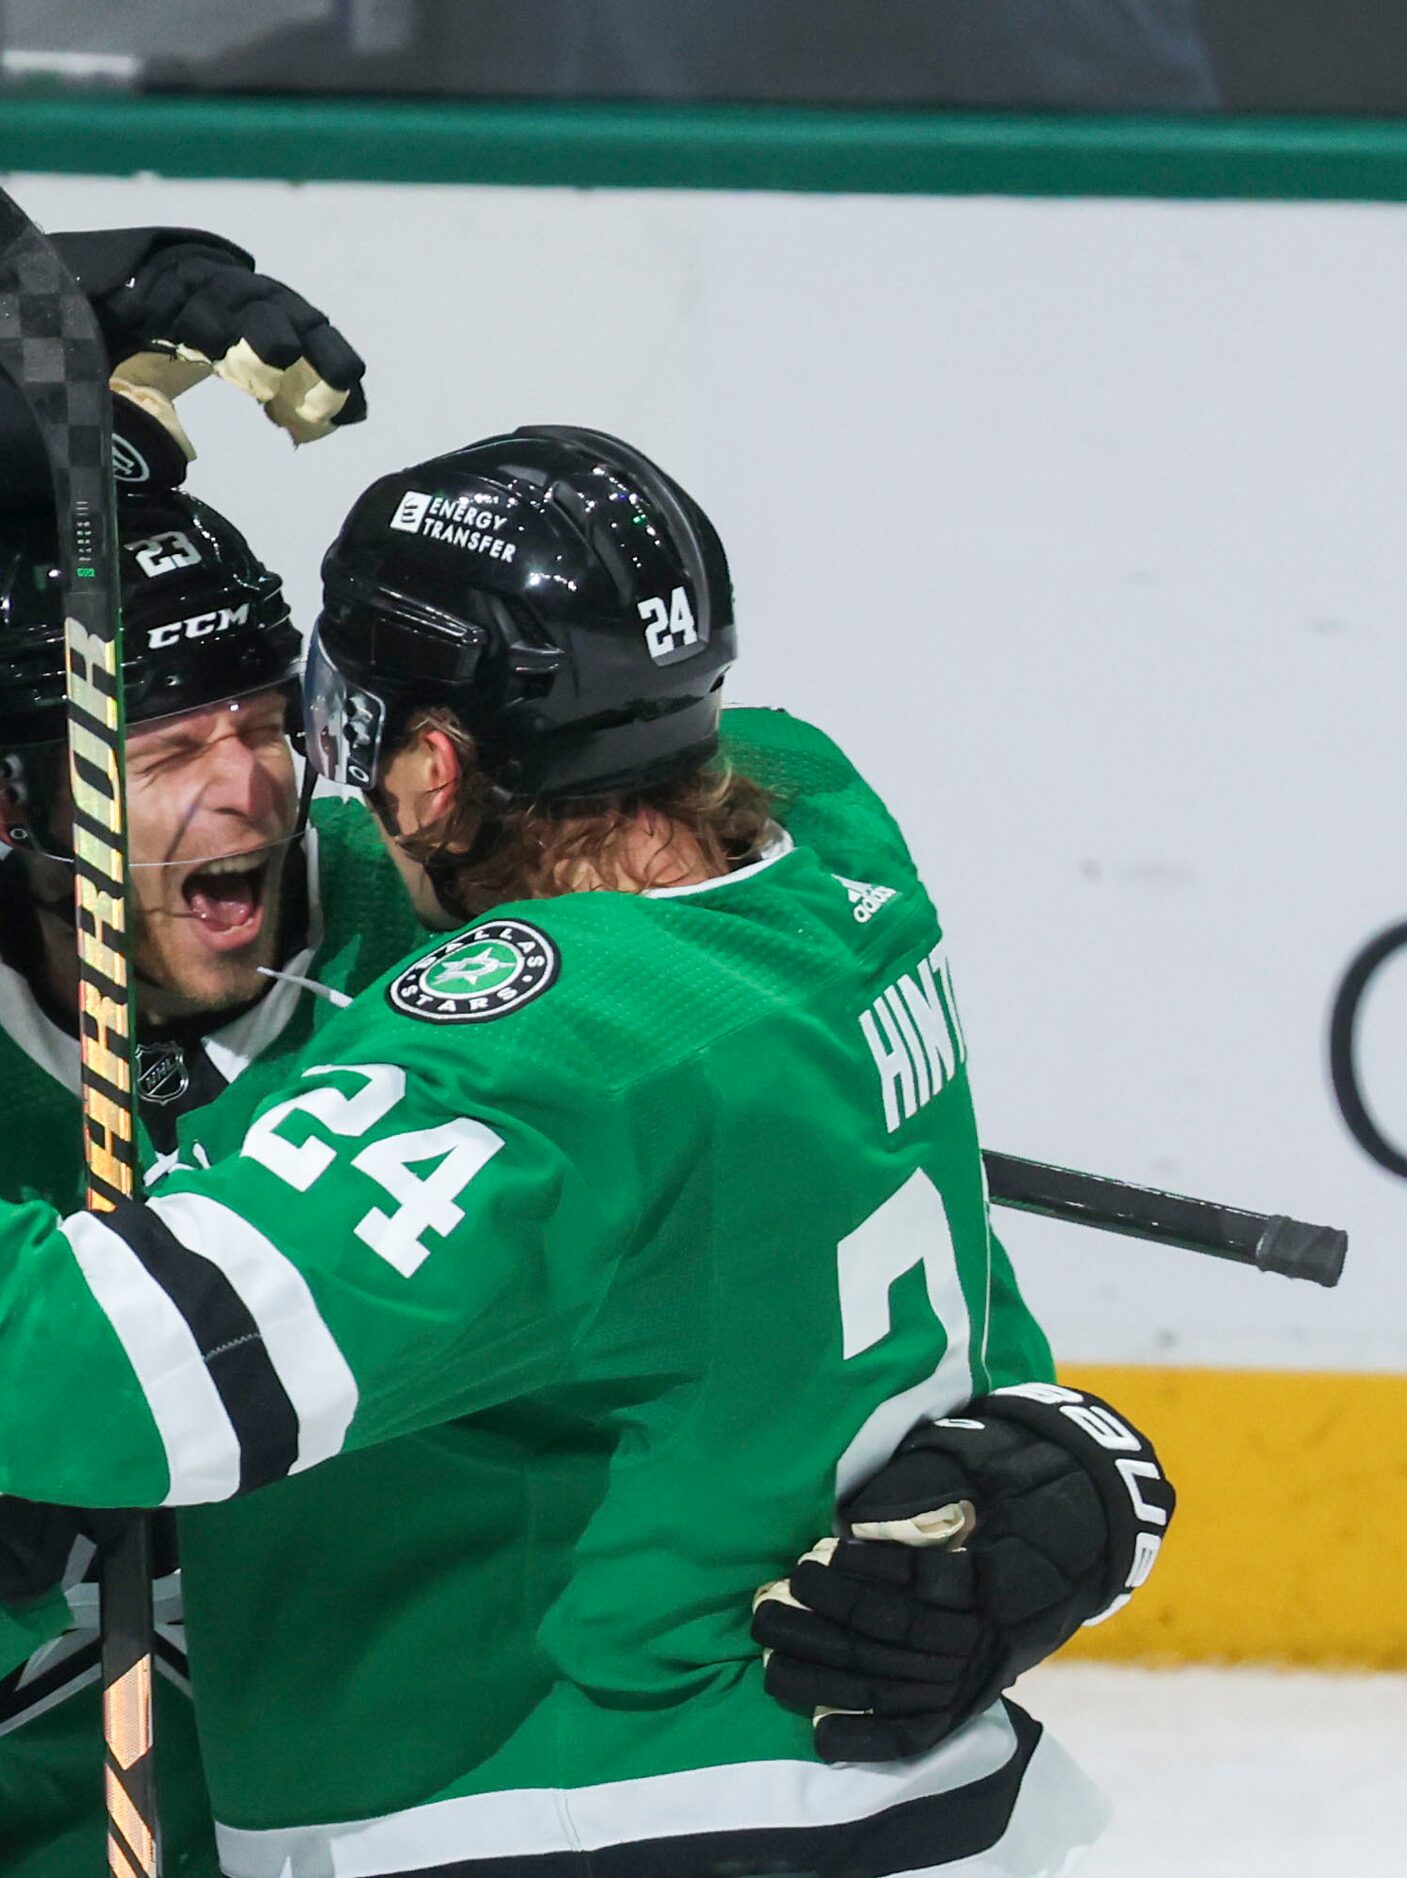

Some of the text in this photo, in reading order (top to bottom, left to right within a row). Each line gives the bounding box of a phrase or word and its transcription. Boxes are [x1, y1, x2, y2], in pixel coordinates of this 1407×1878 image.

[428, 497, 508, 531] ENERGY
[125, 532, 203, 578] 23
[421, 518, 517, 564] TRANSFER
[146, 604, 250, 650] CCM
[638, 586, 699, 659] 24
[64, 615, 134, 1214] ARRIOR
[413, 927, 546, 971] DALLAS
[400, 984, 519, 1013] STARS
[240, 1063, 506, 1280] 24
